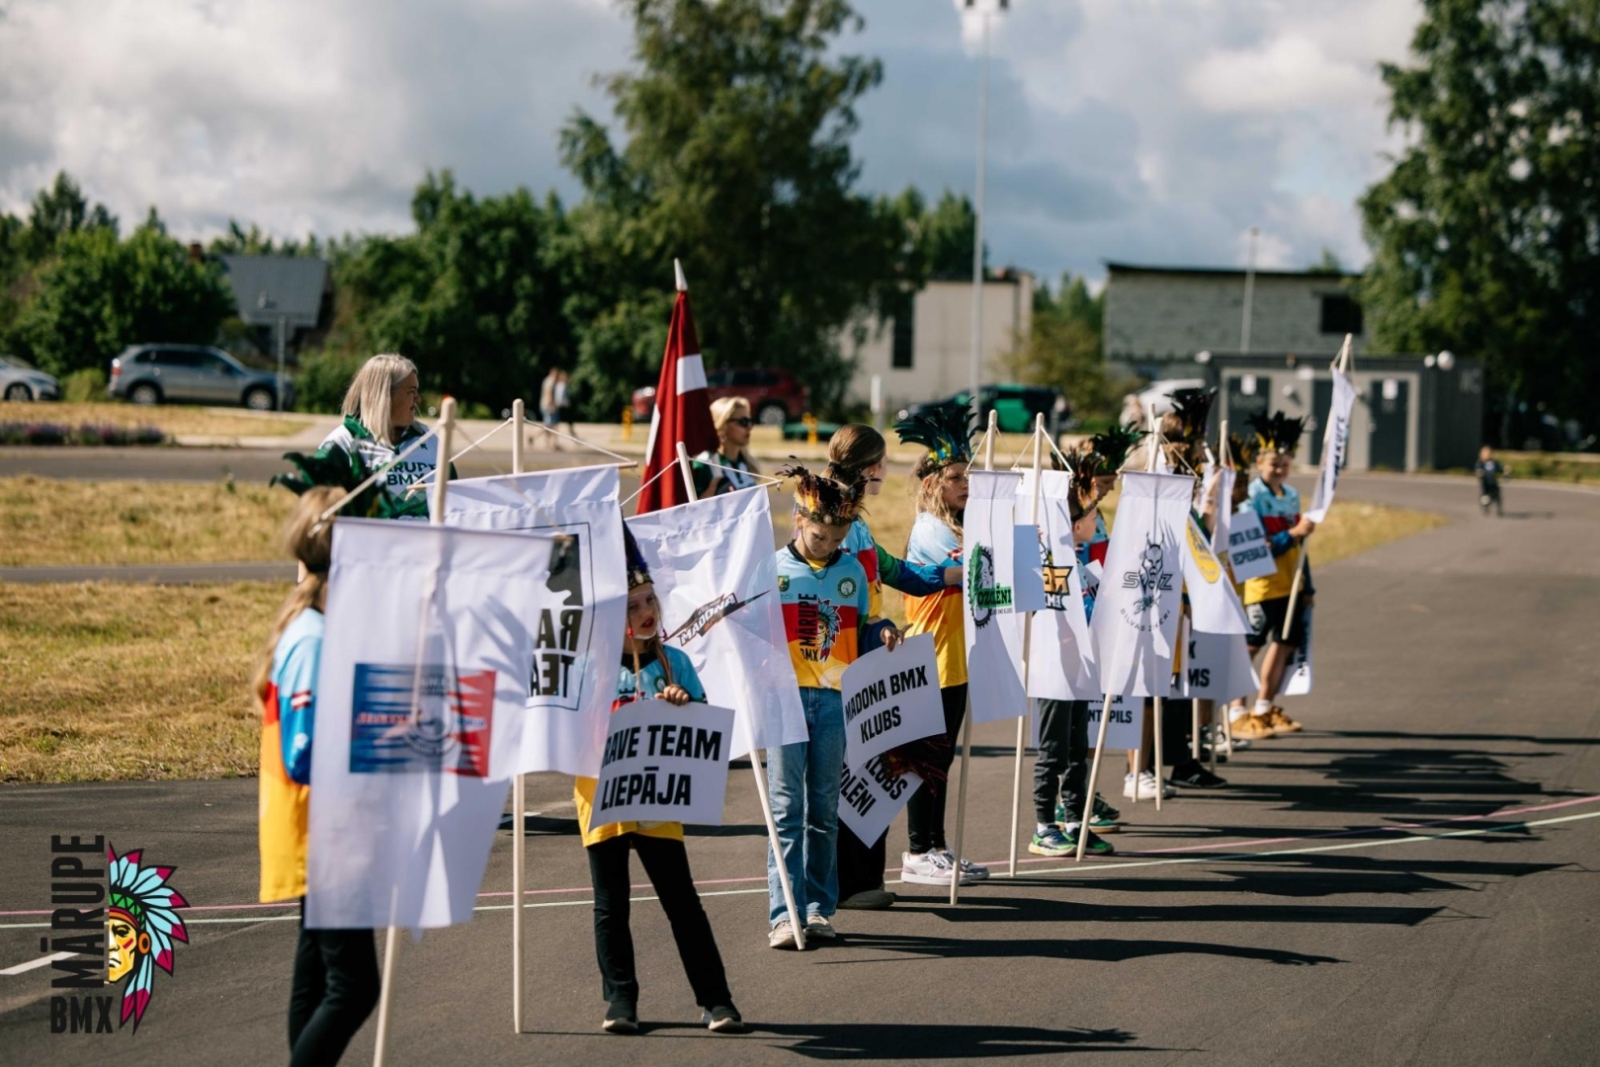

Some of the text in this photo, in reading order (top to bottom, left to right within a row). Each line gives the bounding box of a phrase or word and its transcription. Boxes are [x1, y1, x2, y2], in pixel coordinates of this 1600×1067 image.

[679, 594, 737, 646] MADONA
[844, 665, 928, 726] MADONA BMX
[647, 724, 722, 761] TEAM
[860, 705, 902, 744] KLUBS
[601, 766, 691, 811] LIEPĀJA
[841, 763, 877, 817] OLĒNI
